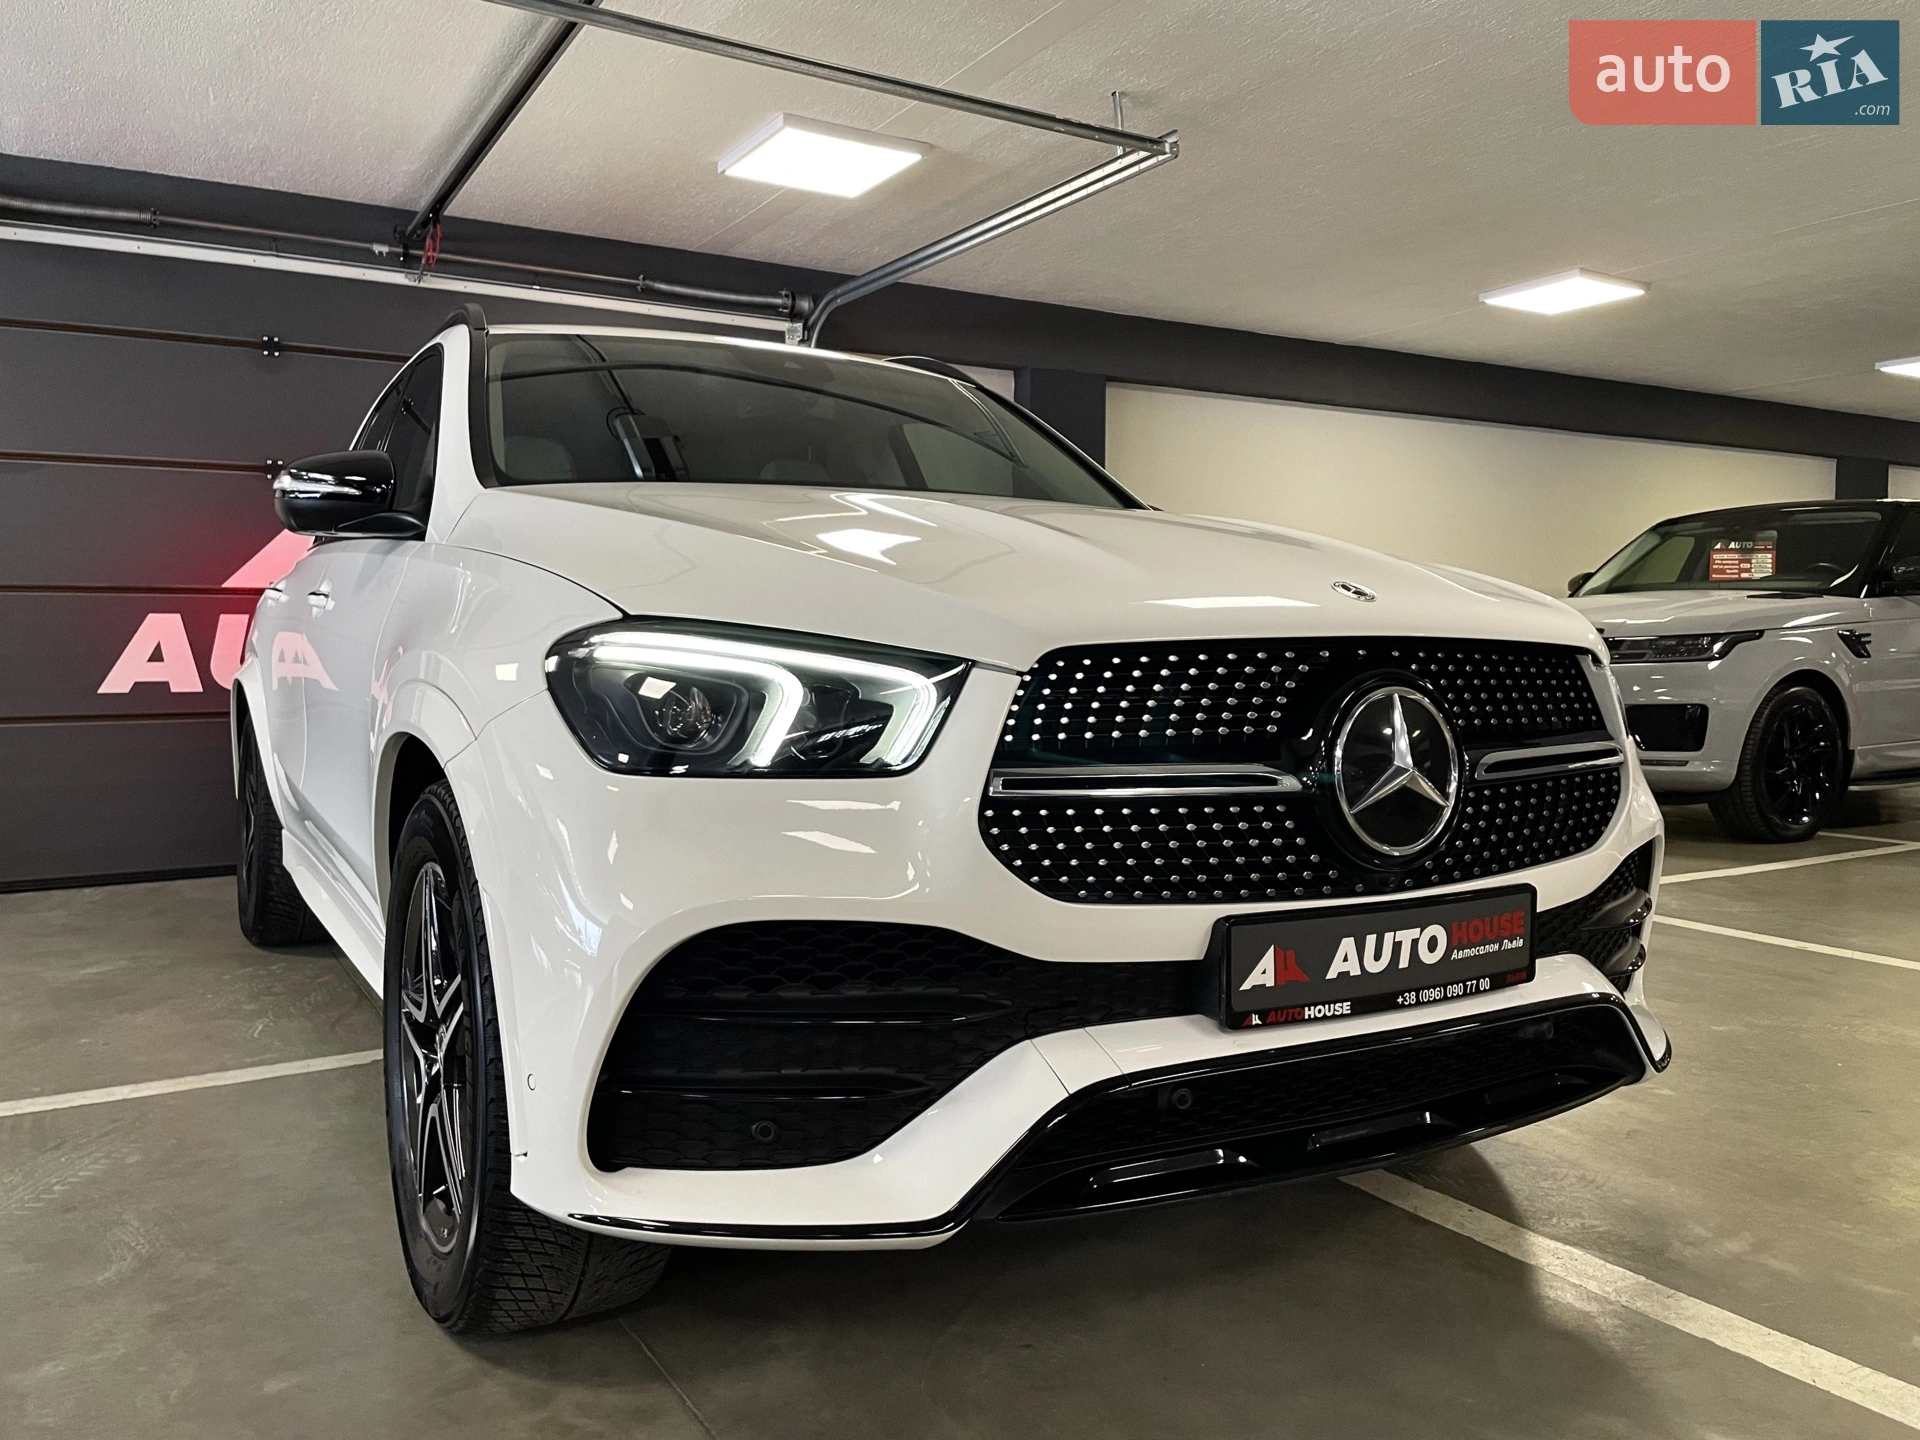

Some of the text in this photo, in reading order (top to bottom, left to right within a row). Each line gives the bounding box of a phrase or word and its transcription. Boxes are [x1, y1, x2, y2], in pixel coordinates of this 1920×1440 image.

[1728, 541, 1753, 549] AUTO
[1325, 911, 1526, 980] AUTO HOUSE
[1450, 936, 1524, 961] Автосалон Львів
[1396, 990, 1417, 1006] +38
[1418, 985, 1445, 1003] (096)
[1446, 983, 1464, 998] 090
[1465, 980, 1477, 994] 77
[1479, 977, 1491, 991] 00
